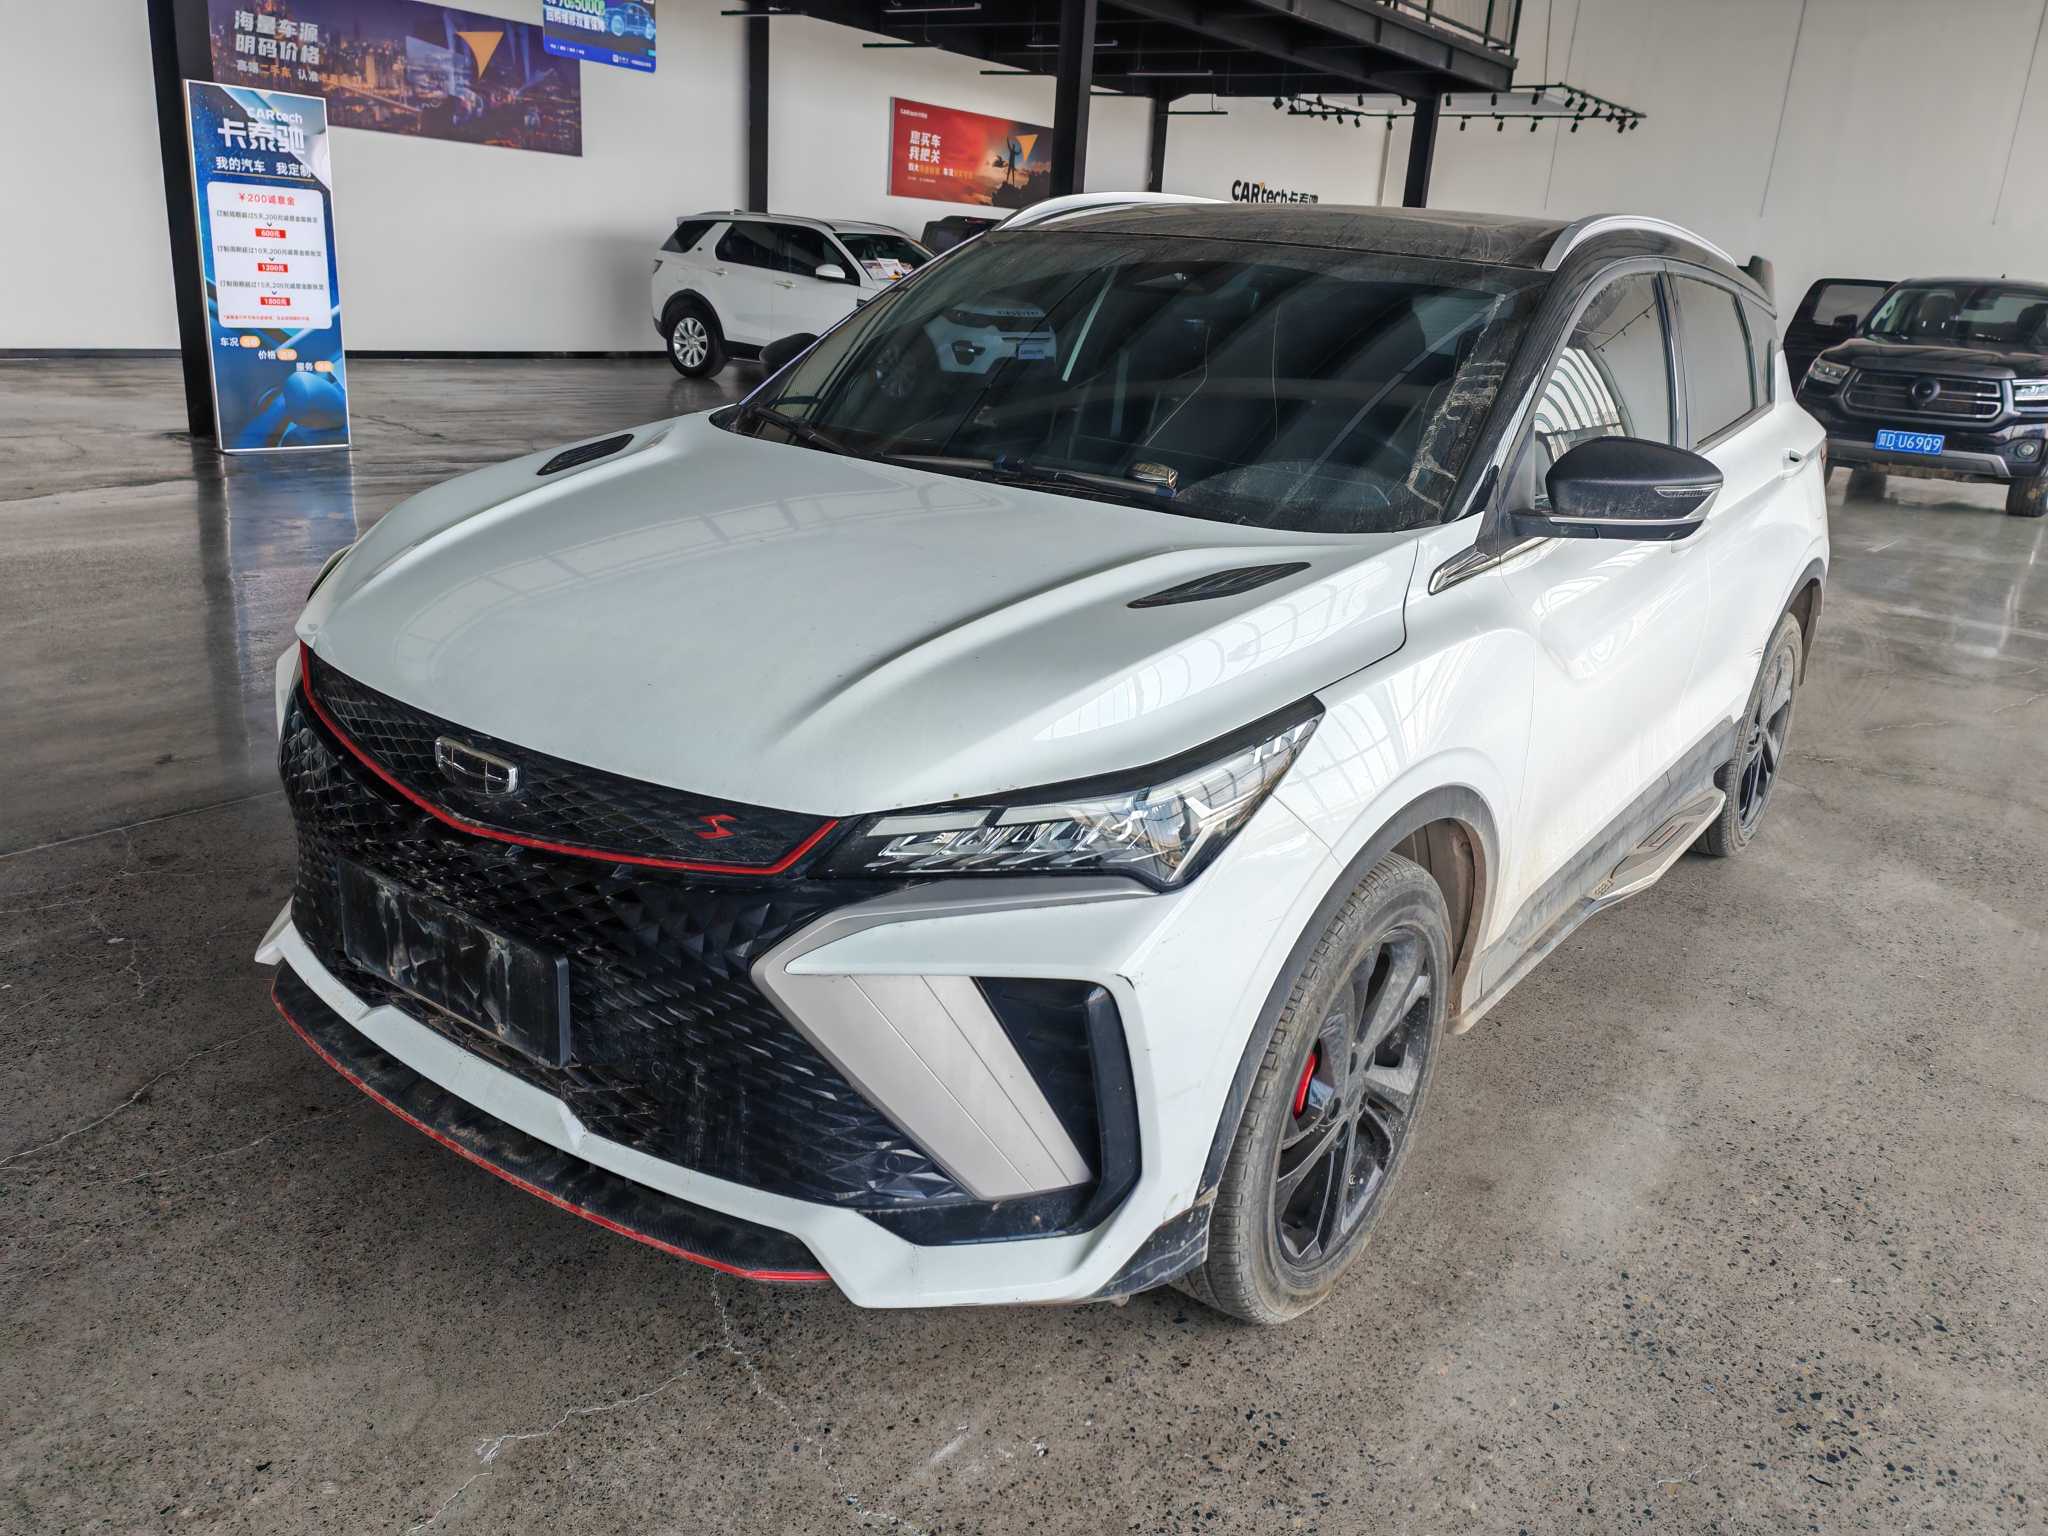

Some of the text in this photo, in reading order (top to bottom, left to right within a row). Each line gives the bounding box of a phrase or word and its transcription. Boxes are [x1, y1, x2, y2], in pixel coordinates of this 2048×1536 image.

[234, 10, 319, 42] 海量车源
[235, 34, 320, 65] 明码价格
[217, 118, 305, 153] 卡泰驰
[910, 130, 941, 149] 您买车
[215, 156, 266, 173] 我的汽车
[908, 145, 941, 165] 我把关
